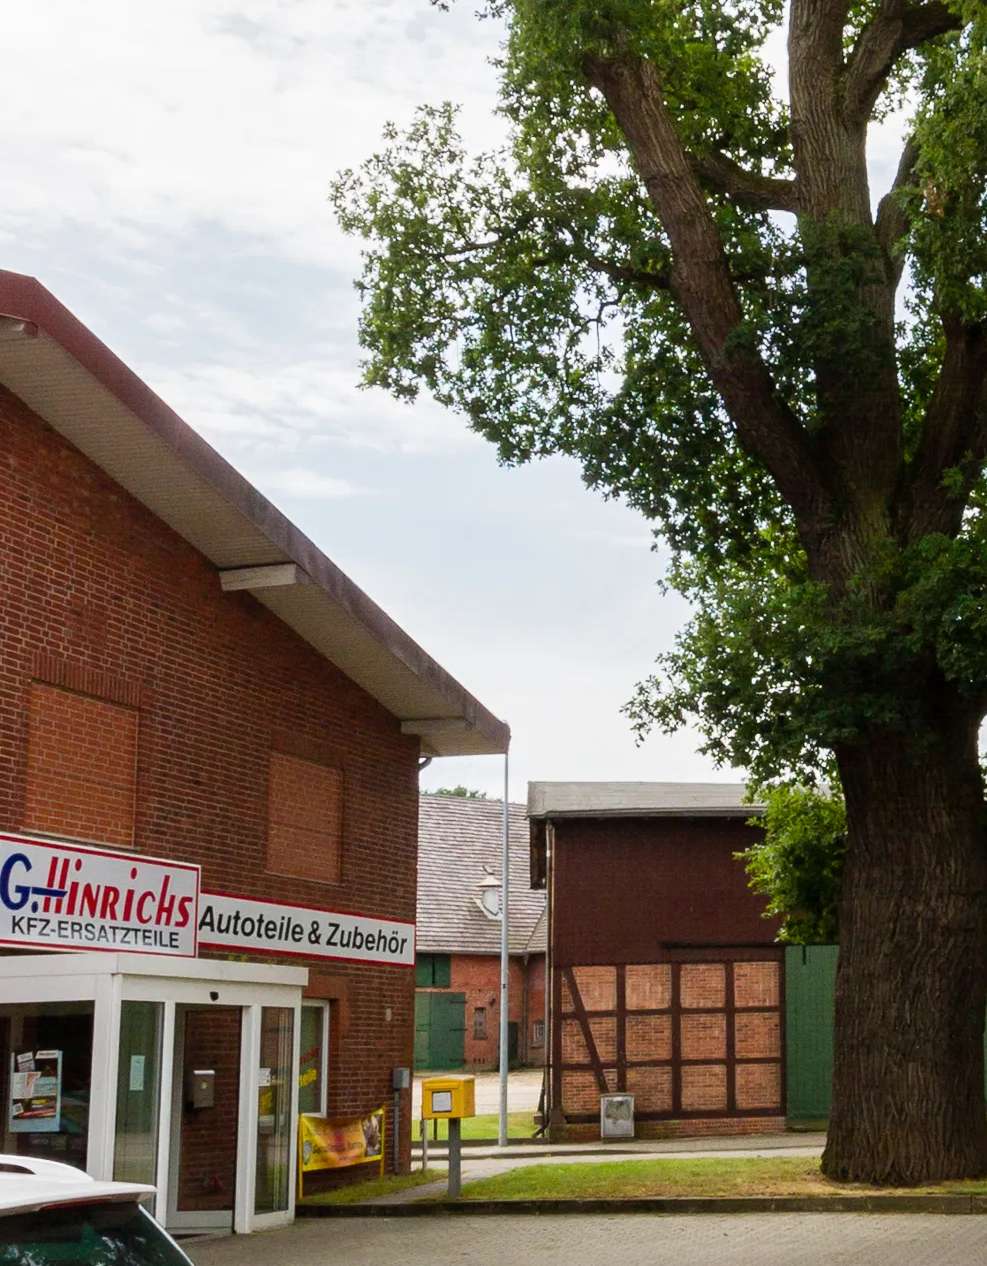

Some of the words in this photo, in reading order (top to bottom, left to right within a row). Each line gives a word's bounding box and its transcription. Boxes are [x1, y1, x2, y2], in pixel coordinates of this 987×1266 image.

[0, 853, 38, 914] G.
[12, 915, 179, 949] KFZ-ERSATZTEILE
[198, 906, 304, 942] Autoteile
[307, 920, 321, 945] &
[326, 922, 408, 955] Zubehör
